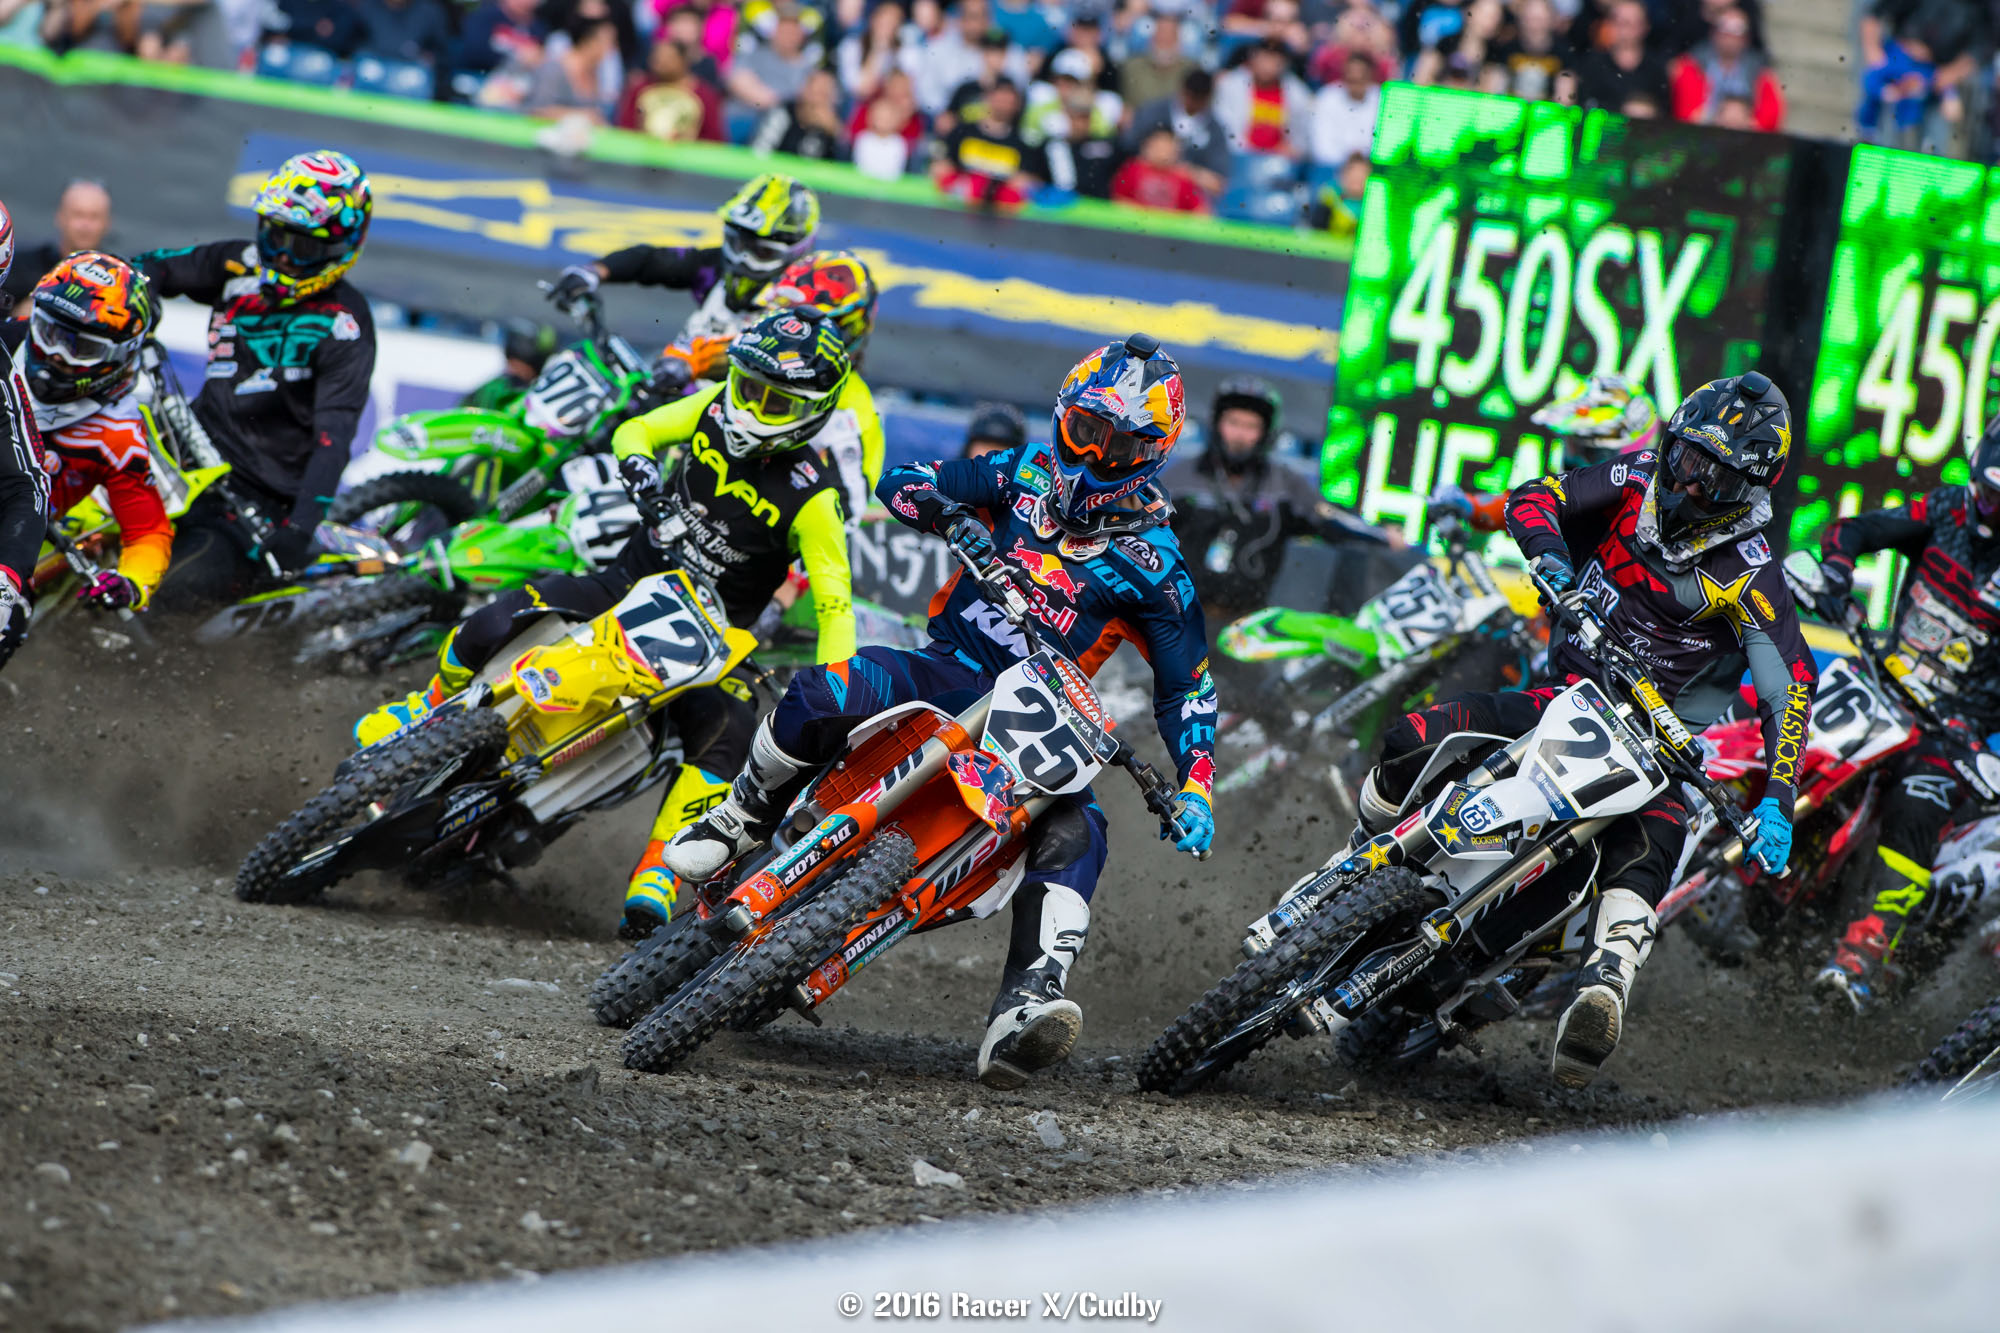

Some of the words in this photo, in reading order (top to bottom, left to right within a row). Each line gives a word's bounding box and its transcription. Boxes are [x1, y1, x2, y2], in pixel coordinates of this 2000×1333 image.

[1389, 216, 1713, 418] 450SX
[1104, 395, 1125, 415] Bull
[671, 492, 712, 544] Soaring
[706, 534, 751, 564] Eagle
[616, 592, 708, 681] 12
[1813, 669, 1872, 733] 16
[552, 727, 607, 768] SHOWA
[987, 686, 1095, 792] 25
[1538, 716, 1641, 810] 21
[768, 829, 824, 872] MOTOREX
[864, 923, 910, 966] MOTOREX
